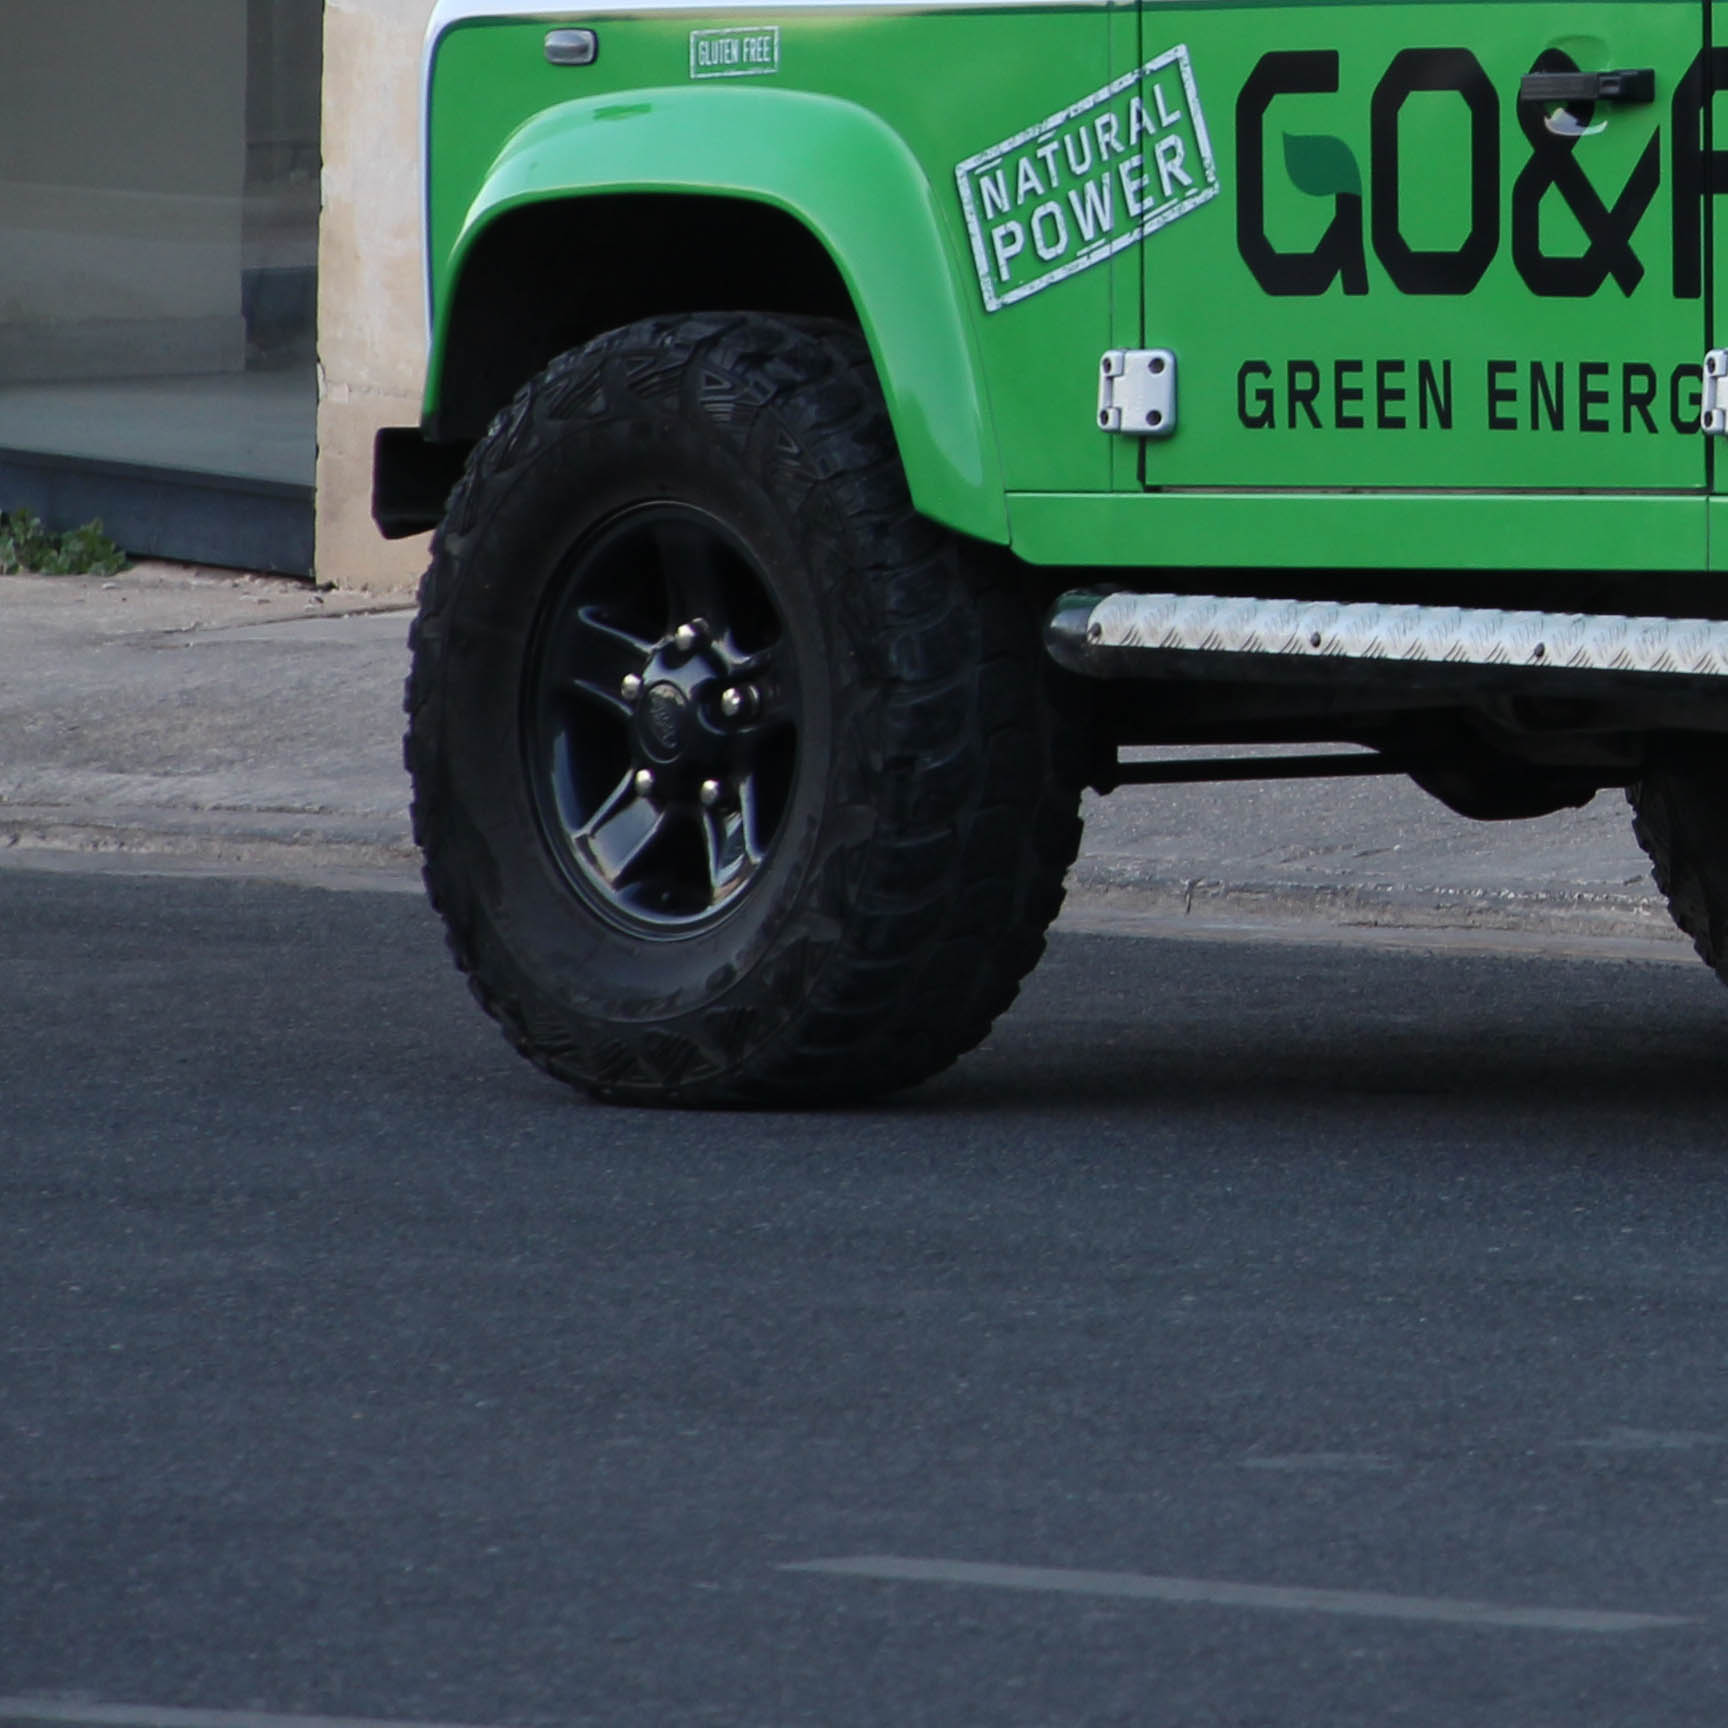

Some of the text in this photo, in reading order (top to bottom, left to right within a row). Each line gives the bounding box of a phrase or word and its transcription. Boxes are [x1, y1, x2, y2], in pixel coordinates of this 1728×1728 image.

[699, 36, 772, 66] GLUTEN FREE
[978, 82, 1182, 220] NATURAL
[990, 134, 1193, 282] POWER
[1236, 359, 1454, 431] GREEN
[1487, 361, 1706, 436] ENERG
